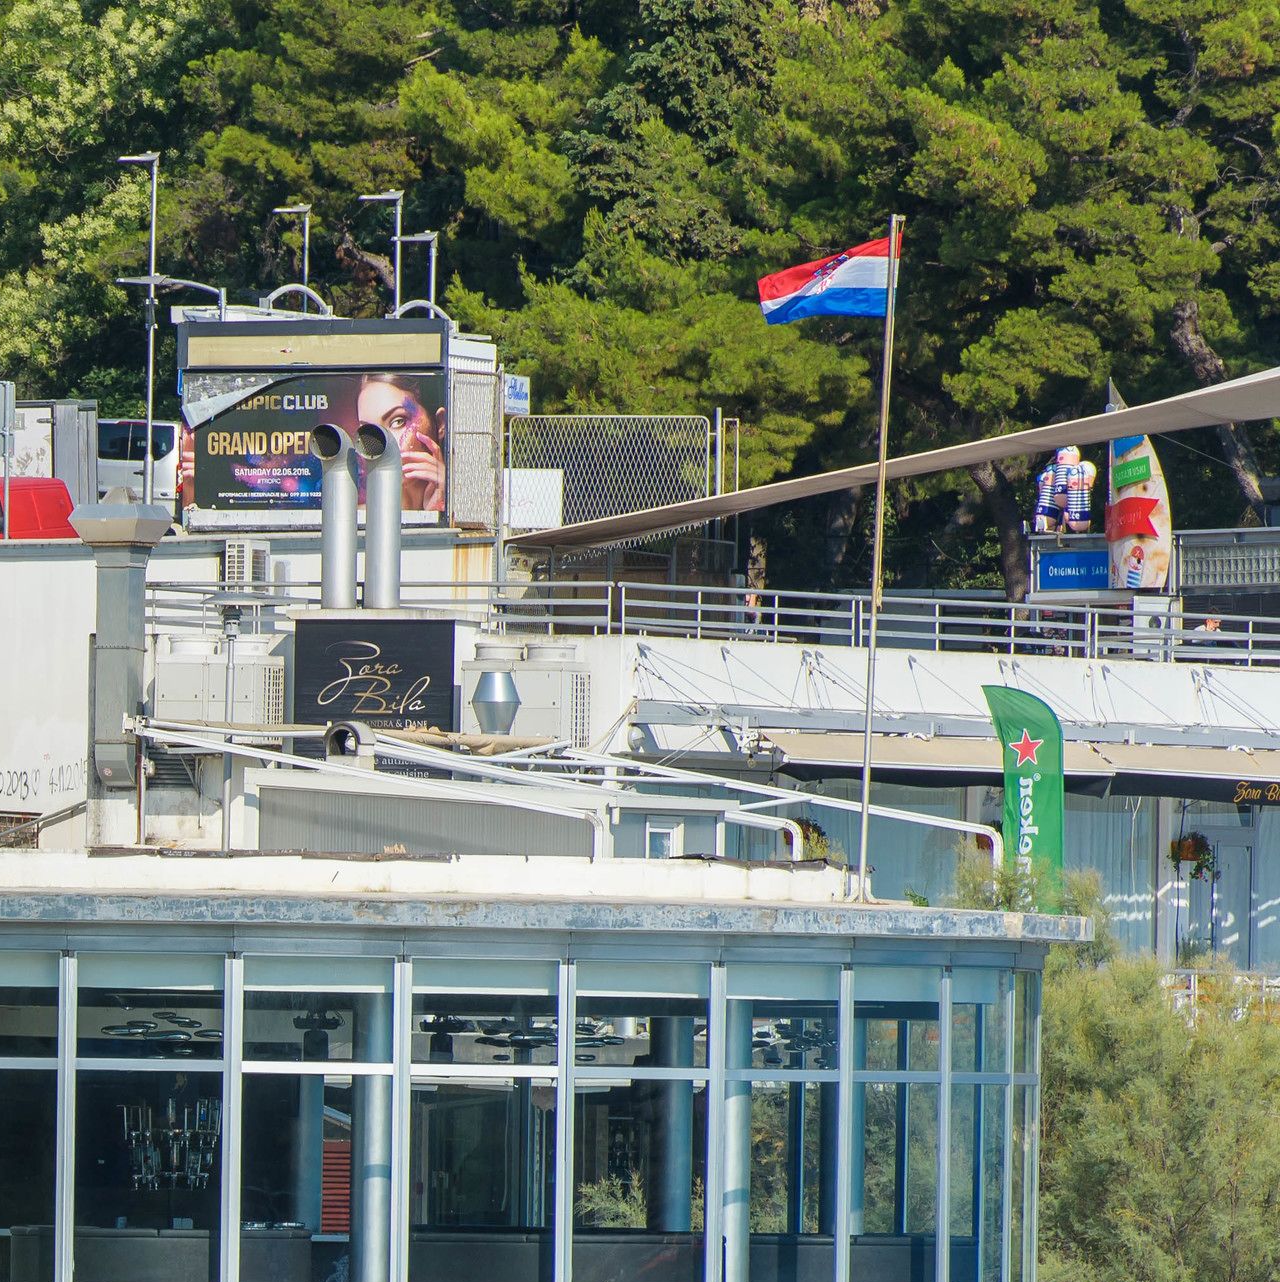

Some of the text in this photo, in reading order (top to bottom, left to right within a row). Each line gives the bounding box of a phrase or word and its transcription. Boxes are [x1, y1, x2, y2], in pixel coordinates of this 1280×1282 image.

[237, 394, 329, 410] OPIC CLUB
[207, 431, 268, 455] GRAND
[234, 468, 272, 476] SATURDAY
[317, 640, 403, 705] Zora
[351, 675, 431, 714] Bila
[1232, 781, 1262, 804] Zora
